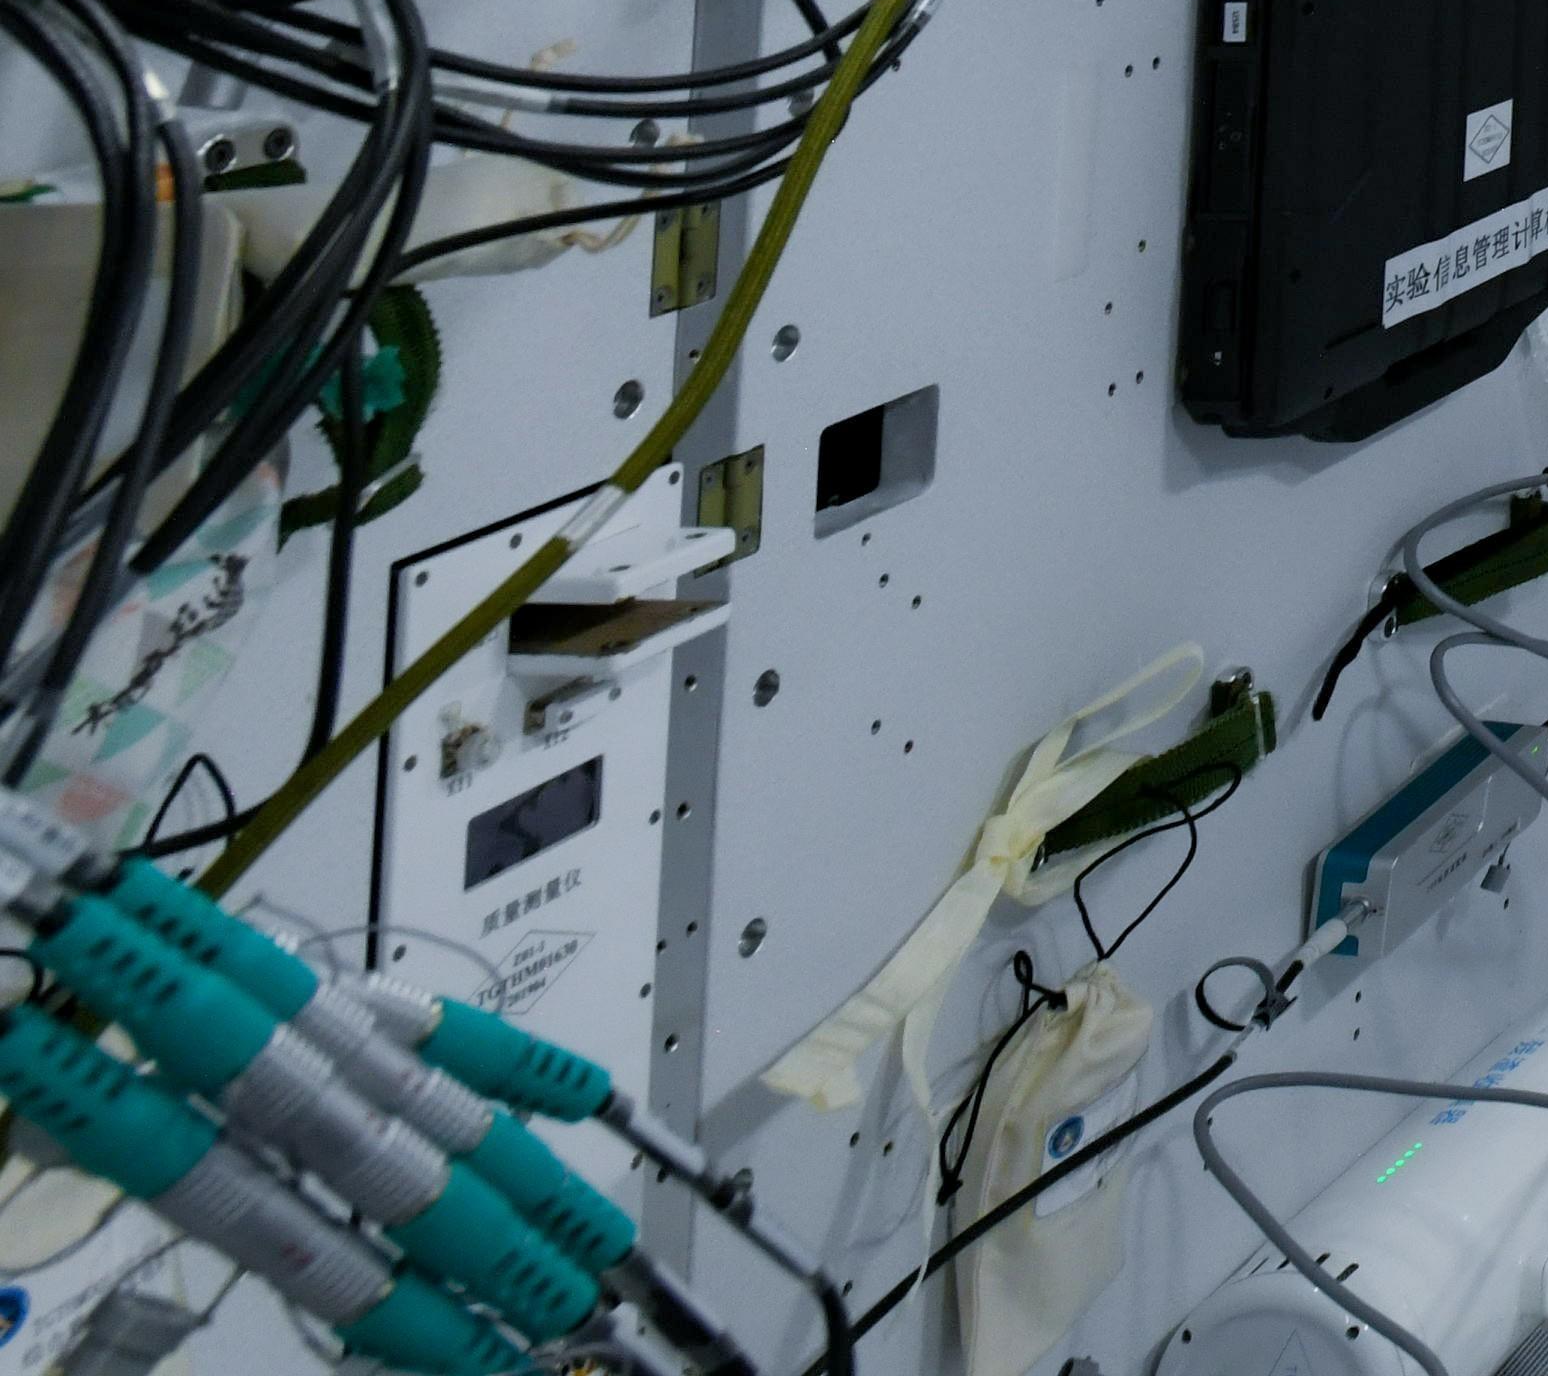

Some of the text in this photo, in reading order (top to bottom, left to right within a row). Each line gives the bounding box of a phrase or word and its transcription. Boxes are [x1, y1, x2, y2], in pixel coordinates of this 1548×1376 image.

[480, 868, 580, 940] 质量测量仪
